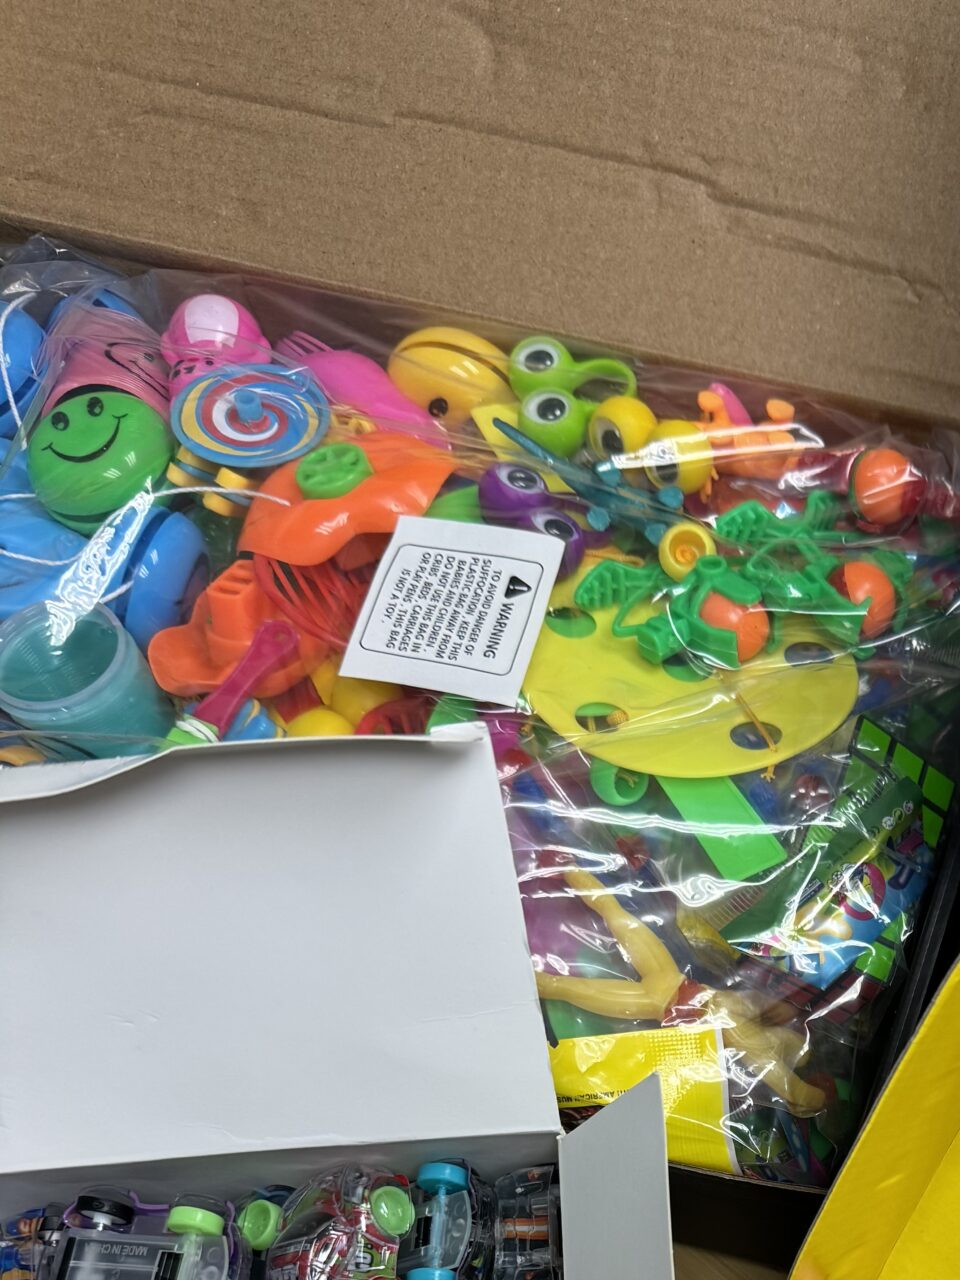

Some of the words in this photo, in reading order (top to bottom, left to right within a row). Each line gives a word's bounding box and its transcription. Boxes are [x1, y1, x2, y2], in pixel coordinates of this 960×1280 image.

[412, 565, 426, 583] PLAY
[436, 571, 450, 588] NOT
[449, 559, 467, 589] BABIES
[460, 556, 481, 592] PLASTIC
[393, 576, 408, 593] NOT
[442, 589, 456, 607] AND
[454, 592, 468, 608] BAG
[481, 583, 498, 609] AVOID
[393, 608, 407, 628] THIS
[421, 603, 437, 621] THIS
[444, 609, 461, 633] AWAY
[397, 604, 423, 652] CARRIAGES
[414, 622, 430, 640] BAG
[455, 620, 470, 640] KEEP
[467, 610, 488, 643] DANGER
[482, 601, 514, 659] WARNING
[385, 630, 400, 648] BAG
[434, 633, 451, 658] FROM
[447, 641, 462, 661] THIS
